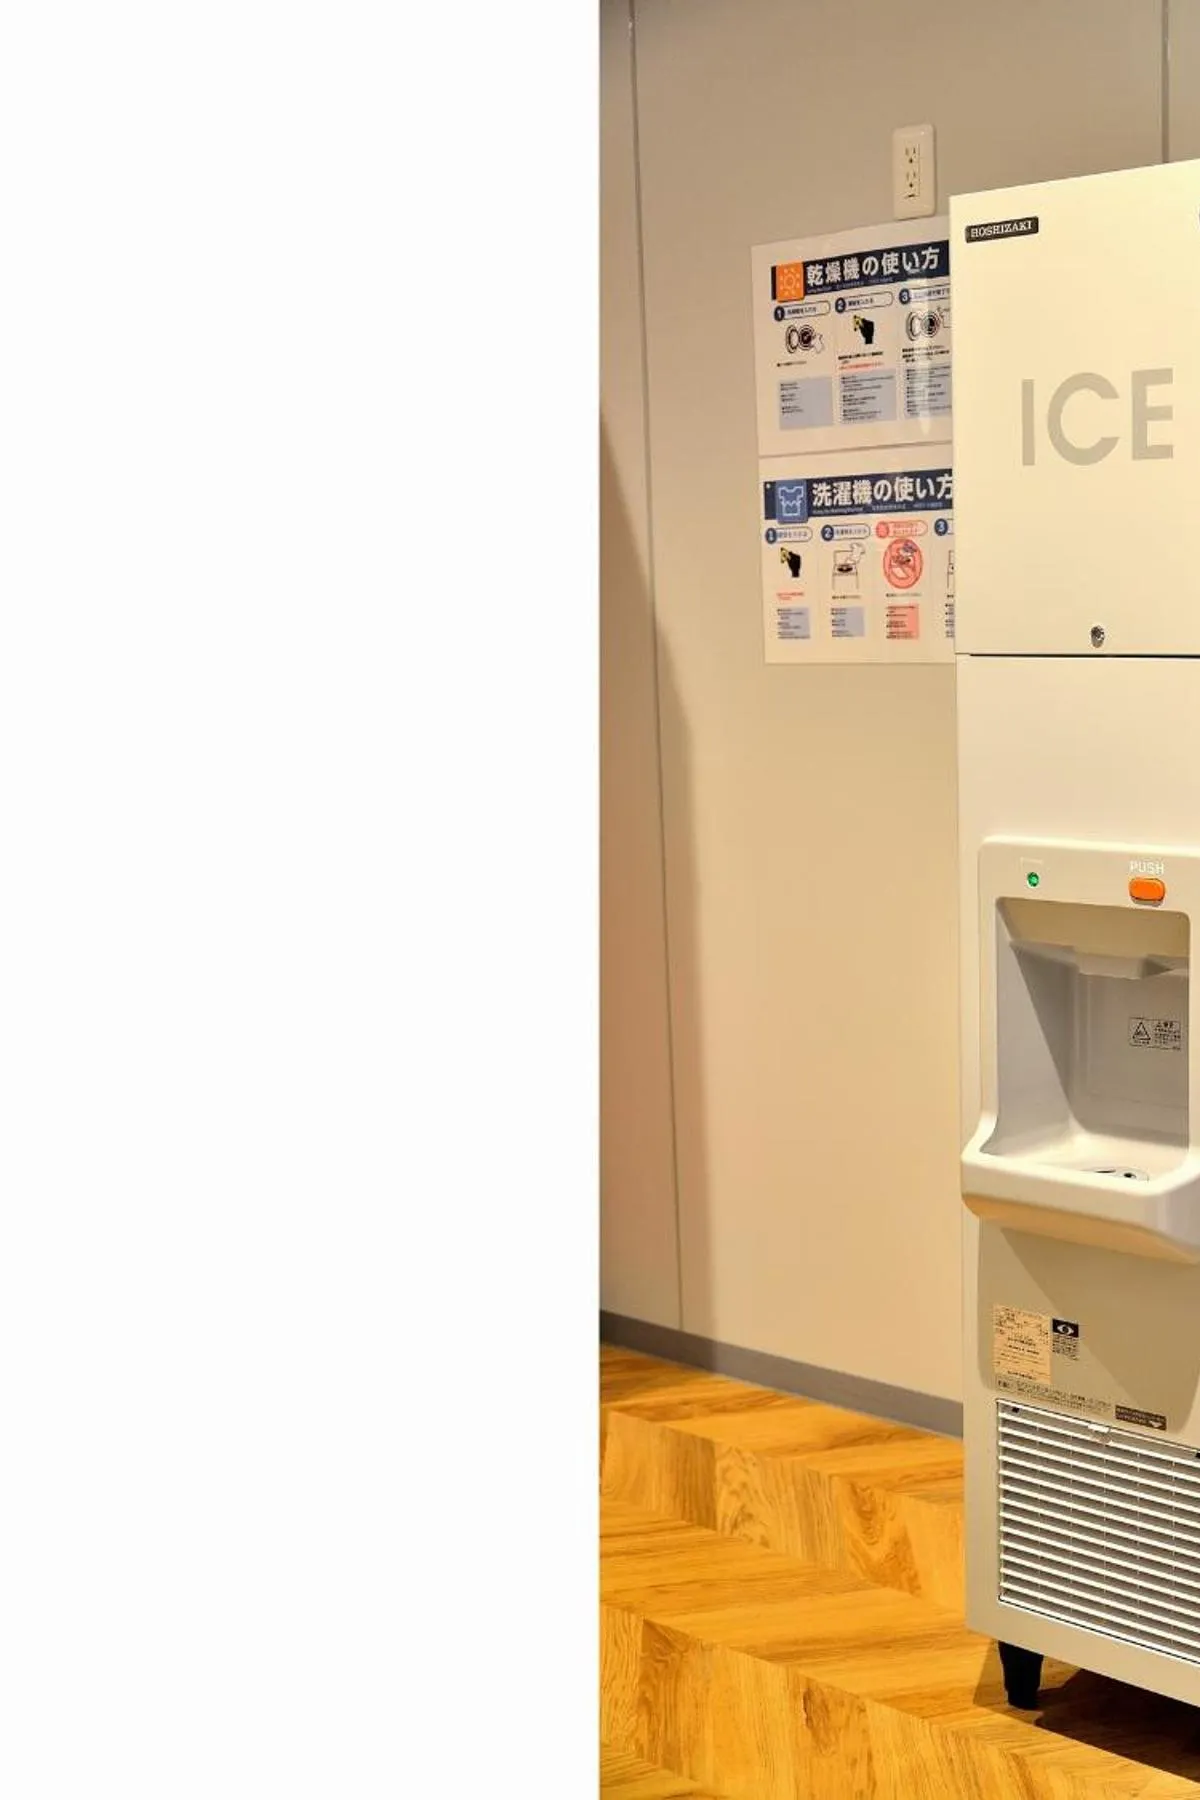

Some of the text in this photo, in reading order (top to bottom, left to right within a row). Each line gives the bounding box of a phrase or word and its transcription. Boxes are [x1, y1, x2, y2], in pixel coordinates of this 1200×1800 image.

[970, 220, 1033, 238] HOSHIZAKI
[806, 247, 940, 287] 乾燥機の使い方
[1021, 367, 1174, 467] ICE
[812, 474, 953, 506] 洗濯機の使い方
[1129, 860, 1164, 875] PUSH
